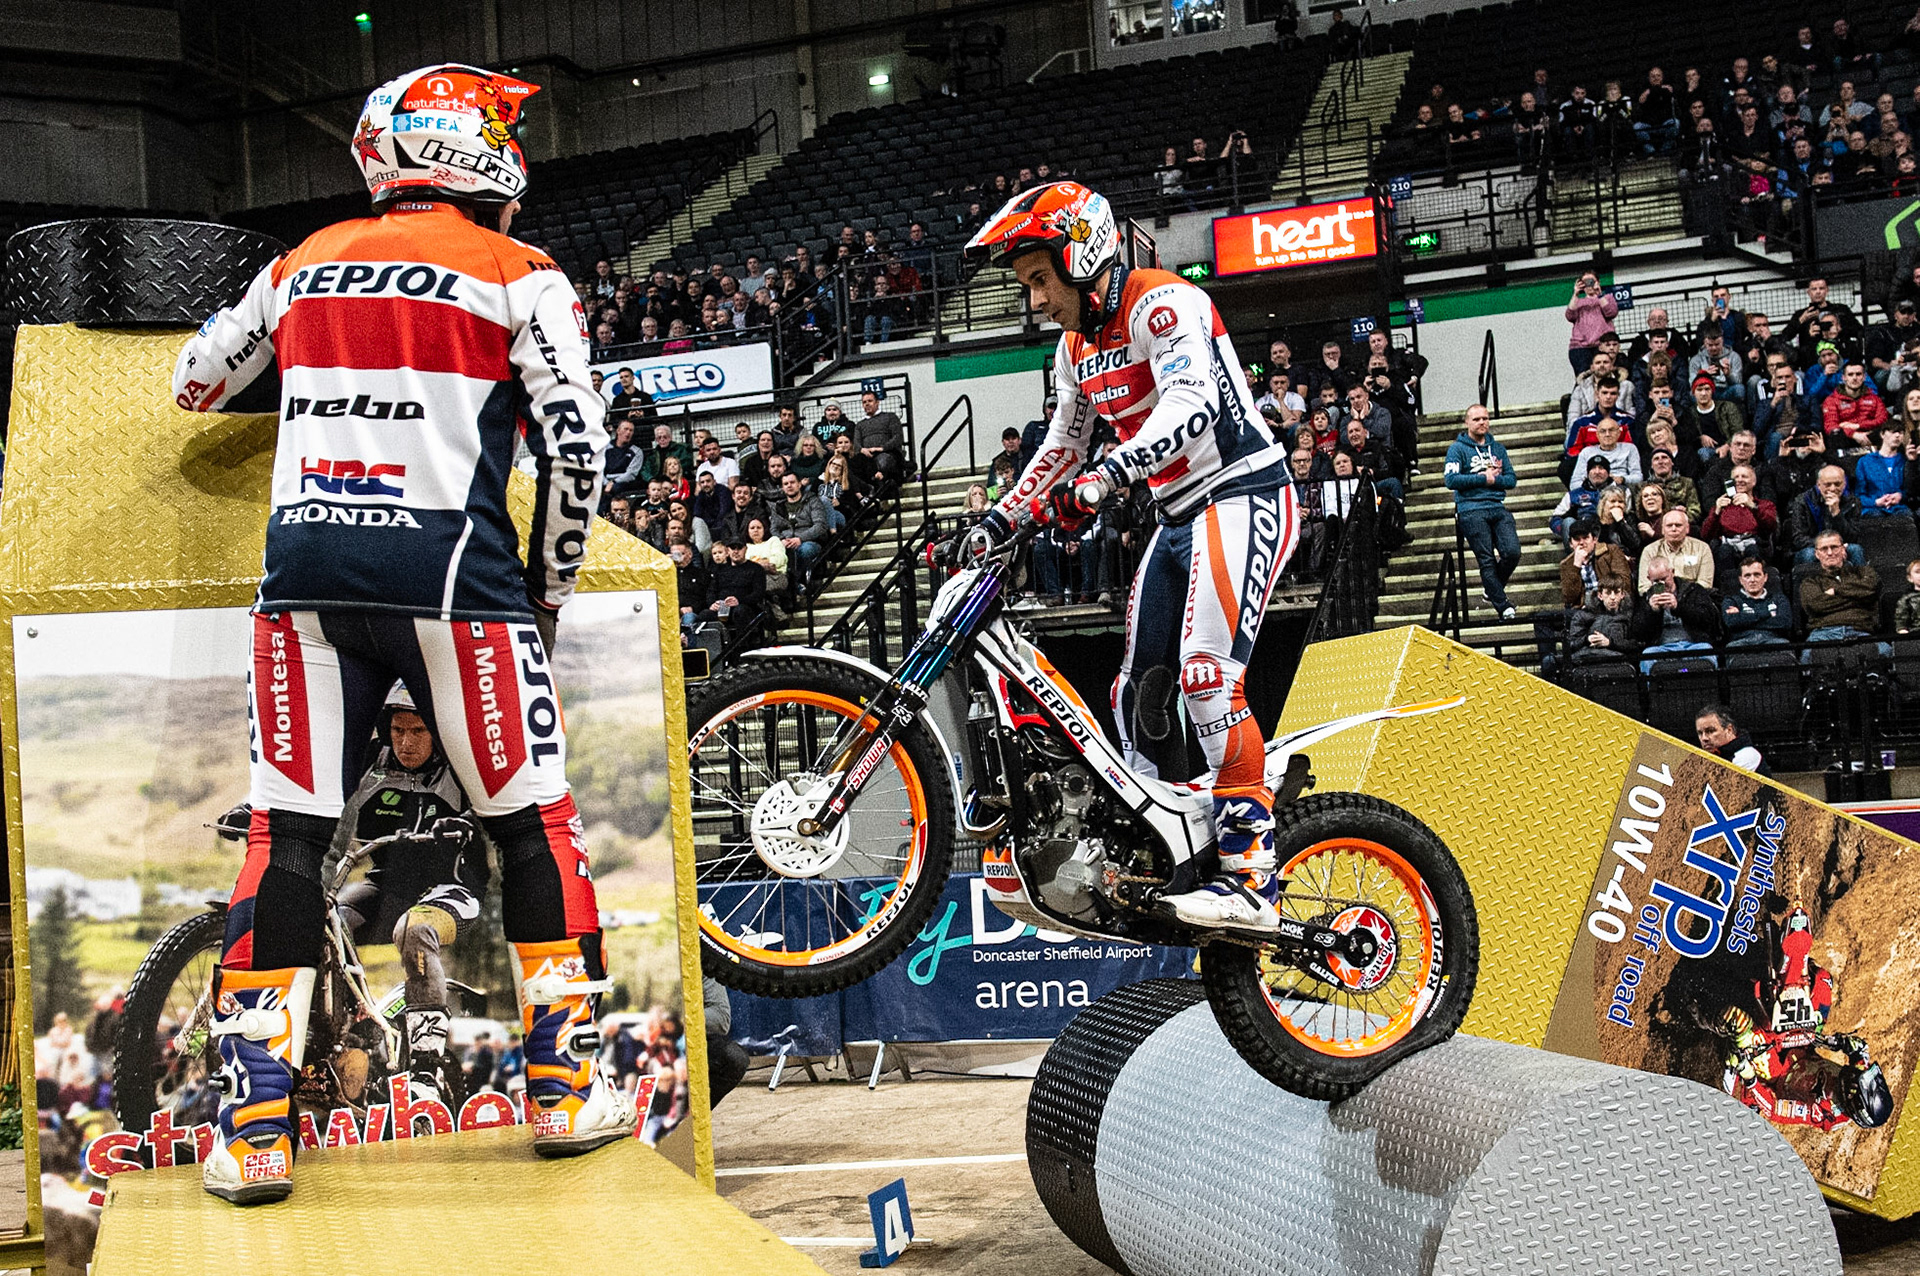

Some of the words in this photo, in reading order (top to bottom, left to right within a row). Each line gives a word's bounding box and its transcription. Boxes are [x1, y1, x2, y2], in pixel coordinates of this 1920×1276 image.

[419, 139, 521, 192] hebo
[1391, 181, 1411, 192] 210
[1252, 204, 1355, 255] heart
[288, 264, 460, 305] REPSOL
[1275, 255, 1289, 264] up
[1612, 290, 1630, 300] 09
[225, 318, 269, 372] heb
[1353, 322, 1374, 333] 110
[284, 394, 426, 422] hebo
[601, 362, 725, 406] OREO
[1090, 384, 1131, 405] hebo
[1122, 400, 1221, 471] REPSOL
[300, 456, 407, 499] HRC
[542, 399, 602, 583] REPSOL
[1002, 446, 1068, 513] HOND
[279, 504, 423, 529] HONDA
[1240, 494, 1279, 643] REPSOL
[1184, 550, 1201, 643] HONDA
[270, 631, 294, 762] Montesa
[473, 646, 509, 771] Montesa
[517, 630, 560, 767] PSOL
[1026, 675, 1090, 748] REPSOL
[1187, 688, 1223, 700] Montesa
[1194, 705, 1252, 739] hebo
[851, 739, 888, 788] SHOWA
[1104, 766, 1127, 790] HRC
[986, 865, 1014, 877] REPSOL
[1587, 762, 1675, 944] 10W-40
[1650, 783, 1762, 959] xrp
[1726, 812, 1786, 956] synthesis
[866, 881, 915, 939] REPSOL
[1281, 923, 1305, 936] NGK
[1636, 902, 1665, 953] off
[973, 949, 1041, 963] Doncaster
[1043, 946, 1103, 961] Sheffield
[1105, 945, 1152, 962] Airport
[1309, 962, 1340, 986] GALFER
[1361, 935, 1397, 990] Montesa
[1427, 918, 1443, 991] REPSOL
[975, 979, 1092, 1009] arena
[1607, 955, 1647, 1029] road
[245, 1153, 270, 1167] 26
[884, 1197, 910, 1257] 4
